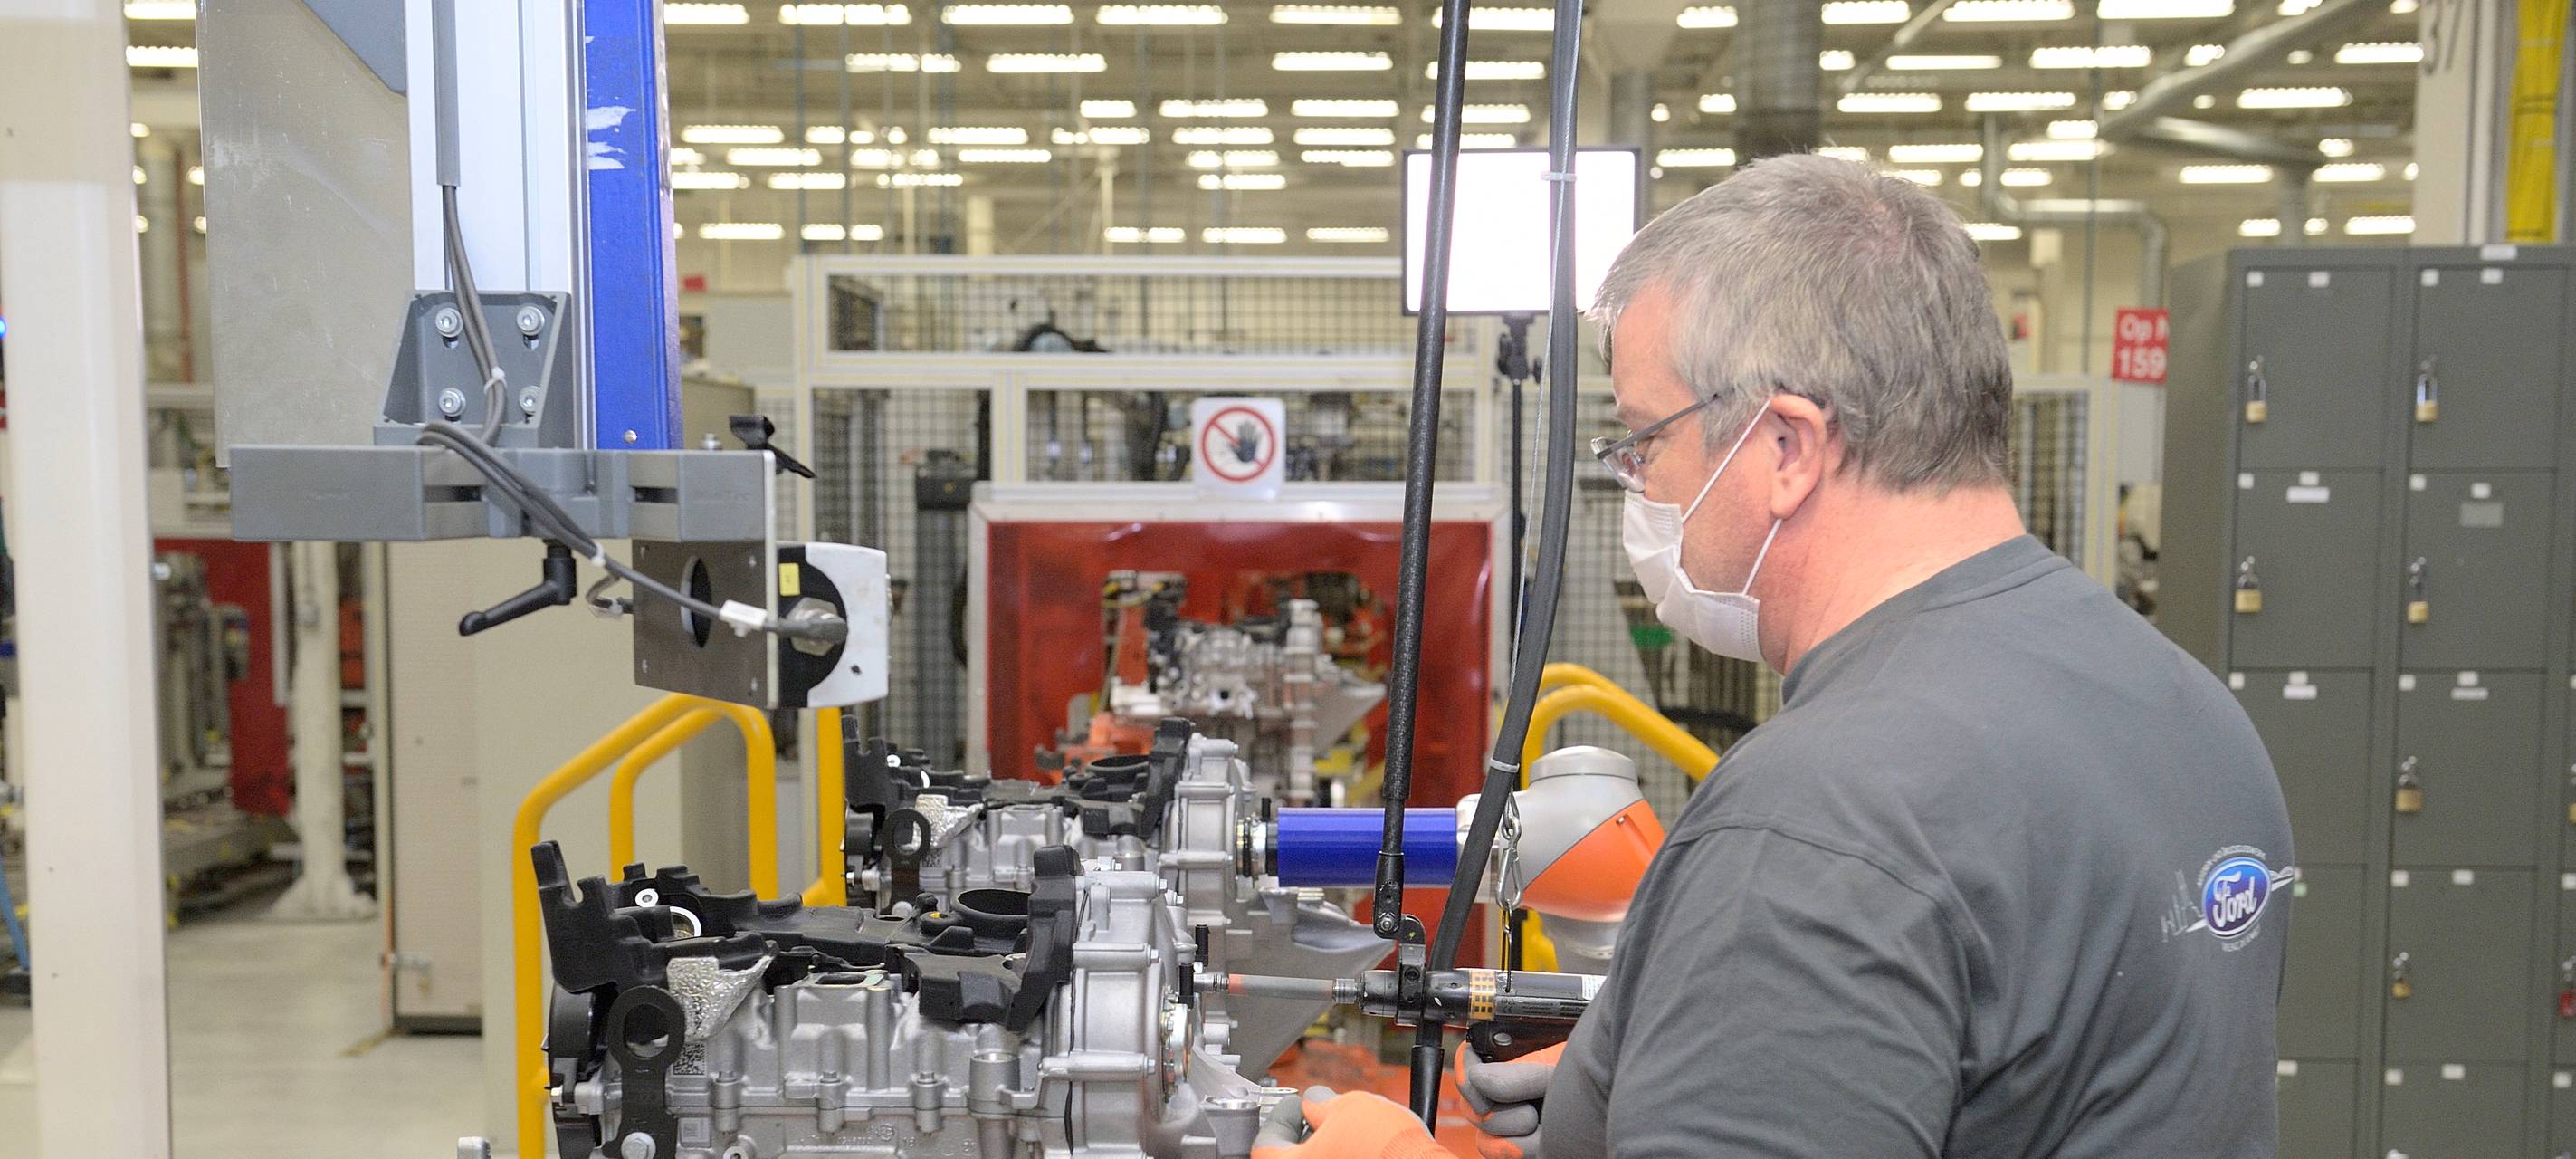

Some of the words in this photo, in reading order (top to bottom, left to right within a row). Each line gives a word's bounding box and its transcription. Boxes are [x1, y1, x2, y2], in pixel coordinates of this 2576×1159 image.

[2120, 313, 2153, 346] Op
[2120, 347, 2167, 378] 159
[2212, 870, 2257, 928] Ford
